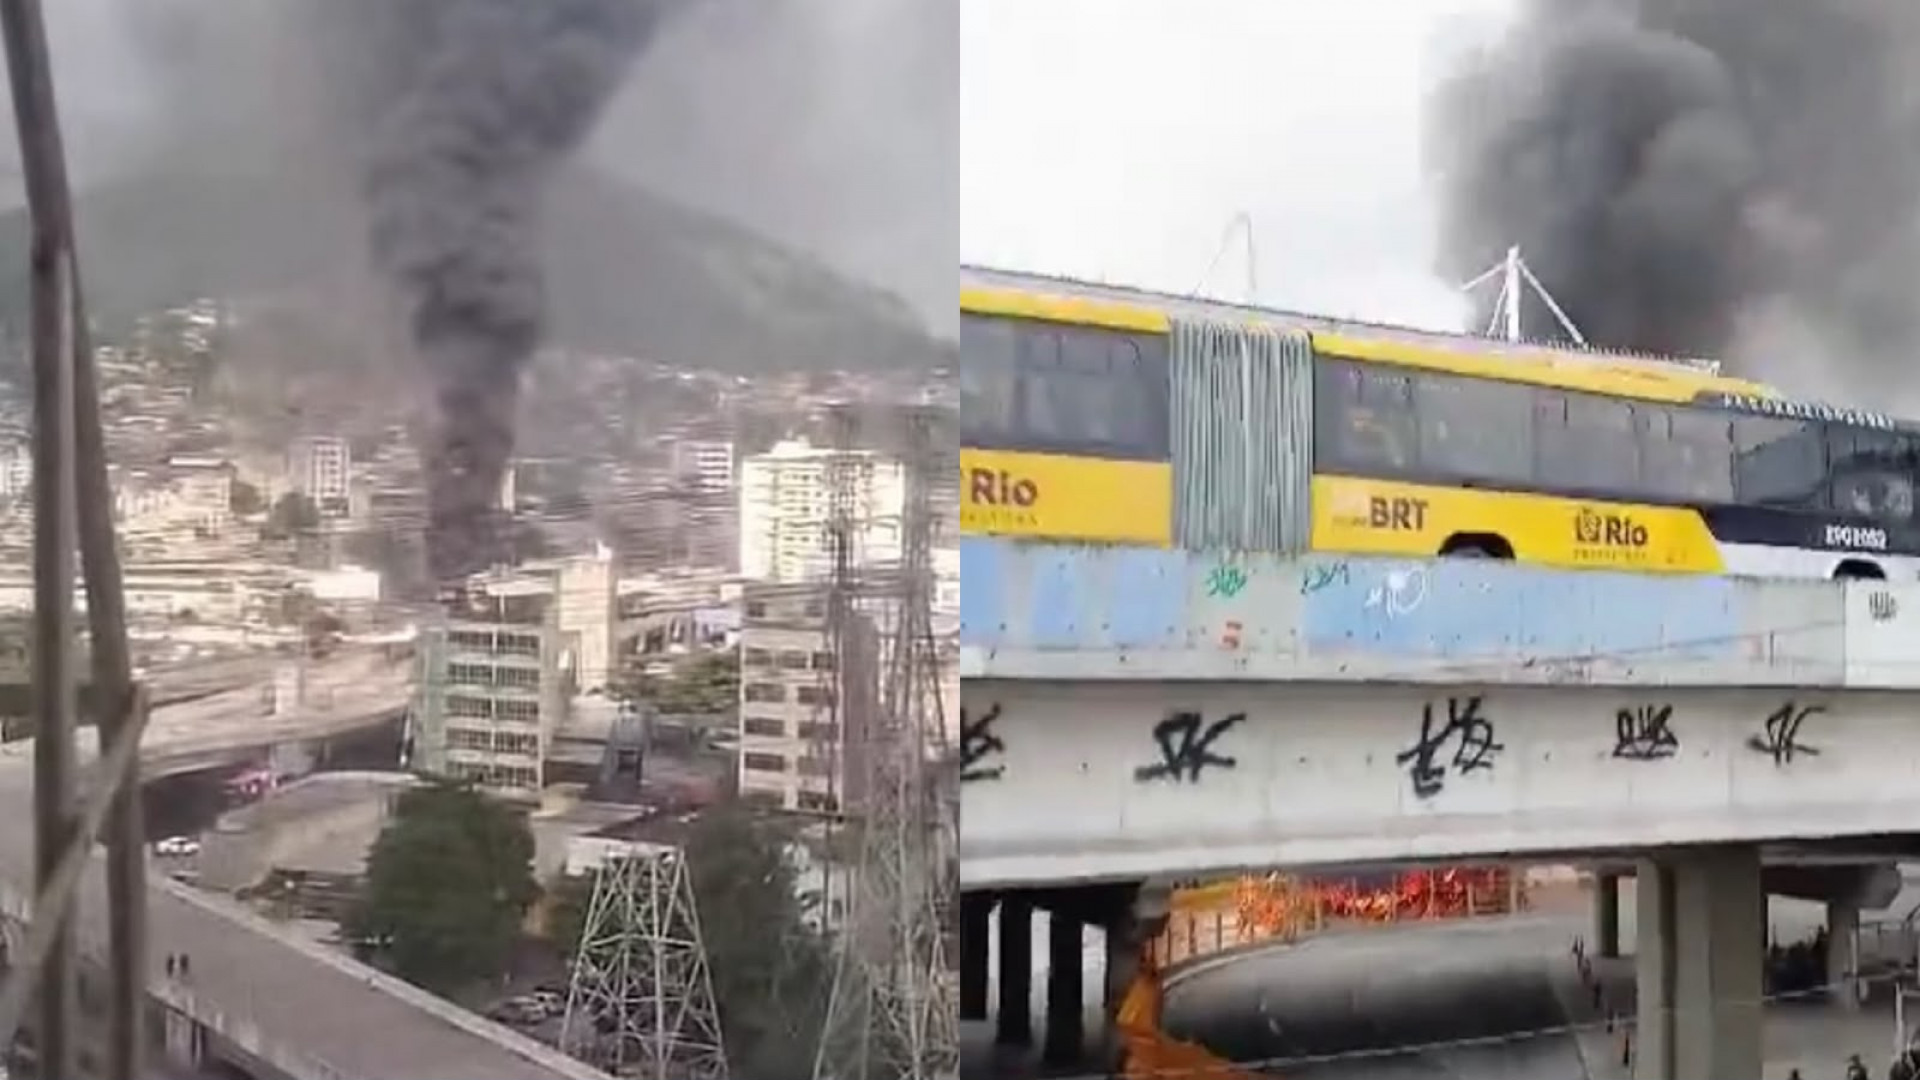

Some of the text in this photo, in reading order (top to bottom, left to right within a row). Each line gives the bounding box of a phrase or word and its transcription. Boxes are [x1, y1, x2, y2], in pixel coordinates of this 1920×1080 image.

[971, 467, 1038, 507] Rio
[1370, 496, 1429, 532] BRT
[1605, 515, 1649, 547] Rio
